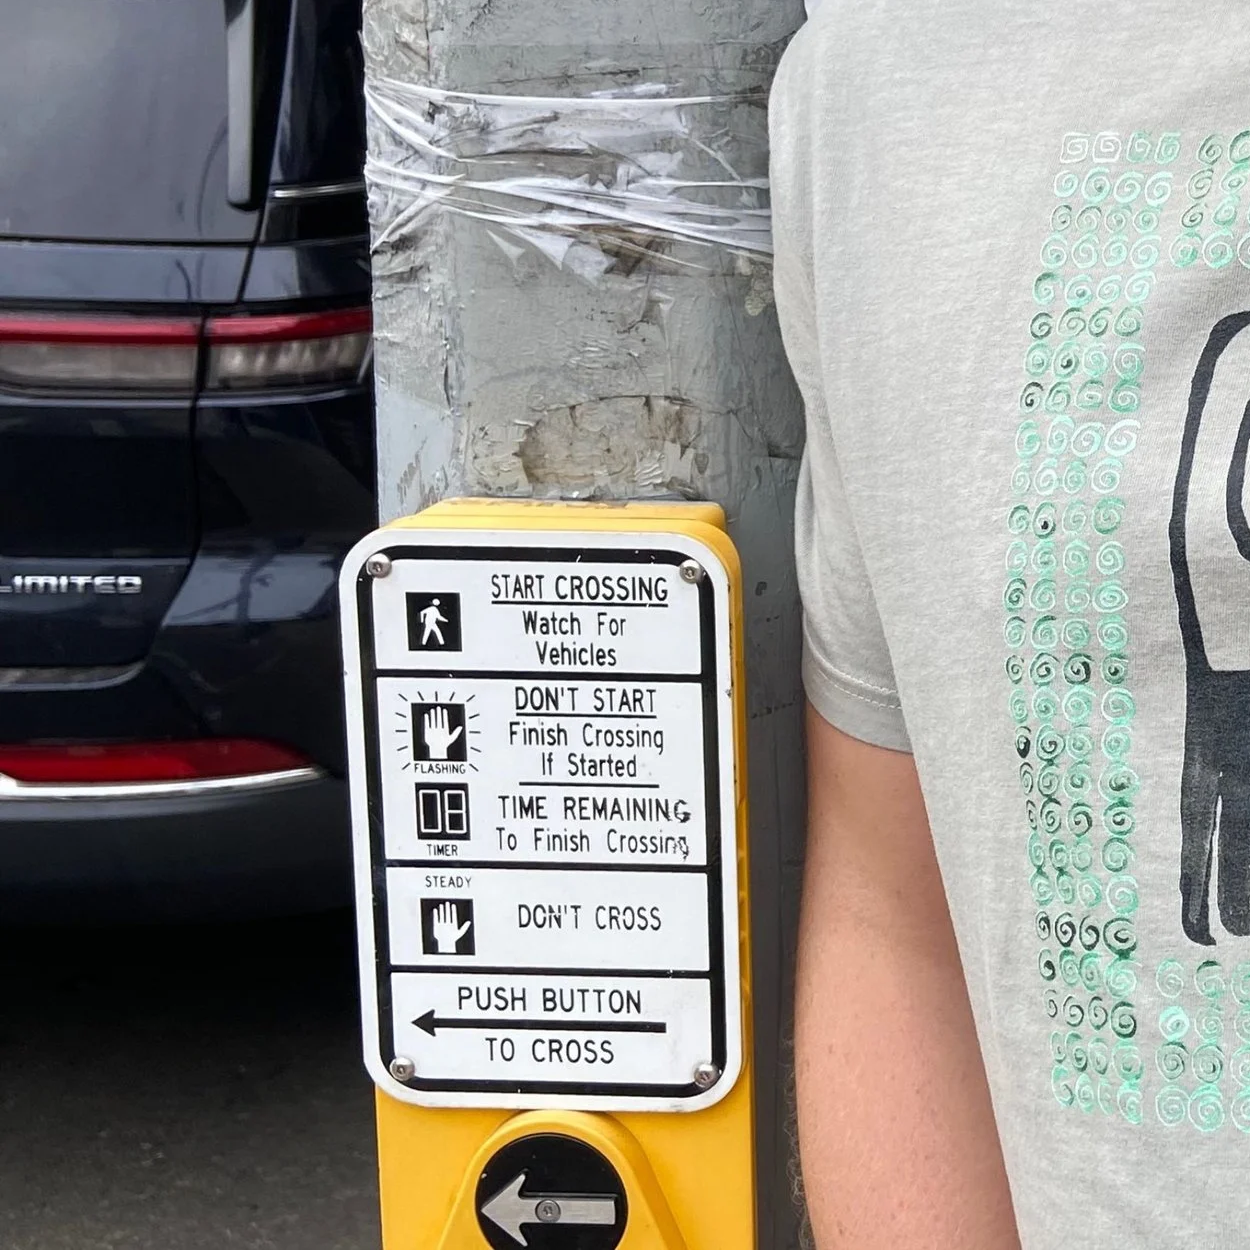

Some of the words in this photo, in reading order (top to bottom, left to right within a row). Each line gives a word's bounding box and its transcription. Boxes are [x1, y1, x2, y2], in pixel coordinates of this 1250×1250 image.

[491, 573, 545, 600] START
[554, 574, 669, 602] CROSSING
[522, 610, 582, 636] Watch
[597, 611, 627, 637] For
[535, 641, 617, 667] Vehicles
[514, 686, 579, 712] DON'T
[593, 688, 657, 713] START
[509, 721, 568, 747] Finish
[582, 722, 664, 755] Crossing
[413, 762, 466, 775] FLASHING
[541, 751, 554, 776] If
[567, 753, 637, 778] Started
[497, 795, 548, 820] TIME
[563, 796, 692, 824] REMAINING
[426, 843, 458, 857] TIMER
[495, 826, 518, 851] To
[533, 827, 590, 853] Finish
[606, 827, 690, 860] Crossing
[424, 875, 472, 888] STEADY
[517, 904, 582, 930] DON'T
[595, 905, 662, 932] CROSS
[457, 986, 527, 1012] PUSH
[542, 987, 642, 1014] BUTTON
[484, 1037, 515, 1062] TO
[531, 1038, 615, 1065] CROSS
